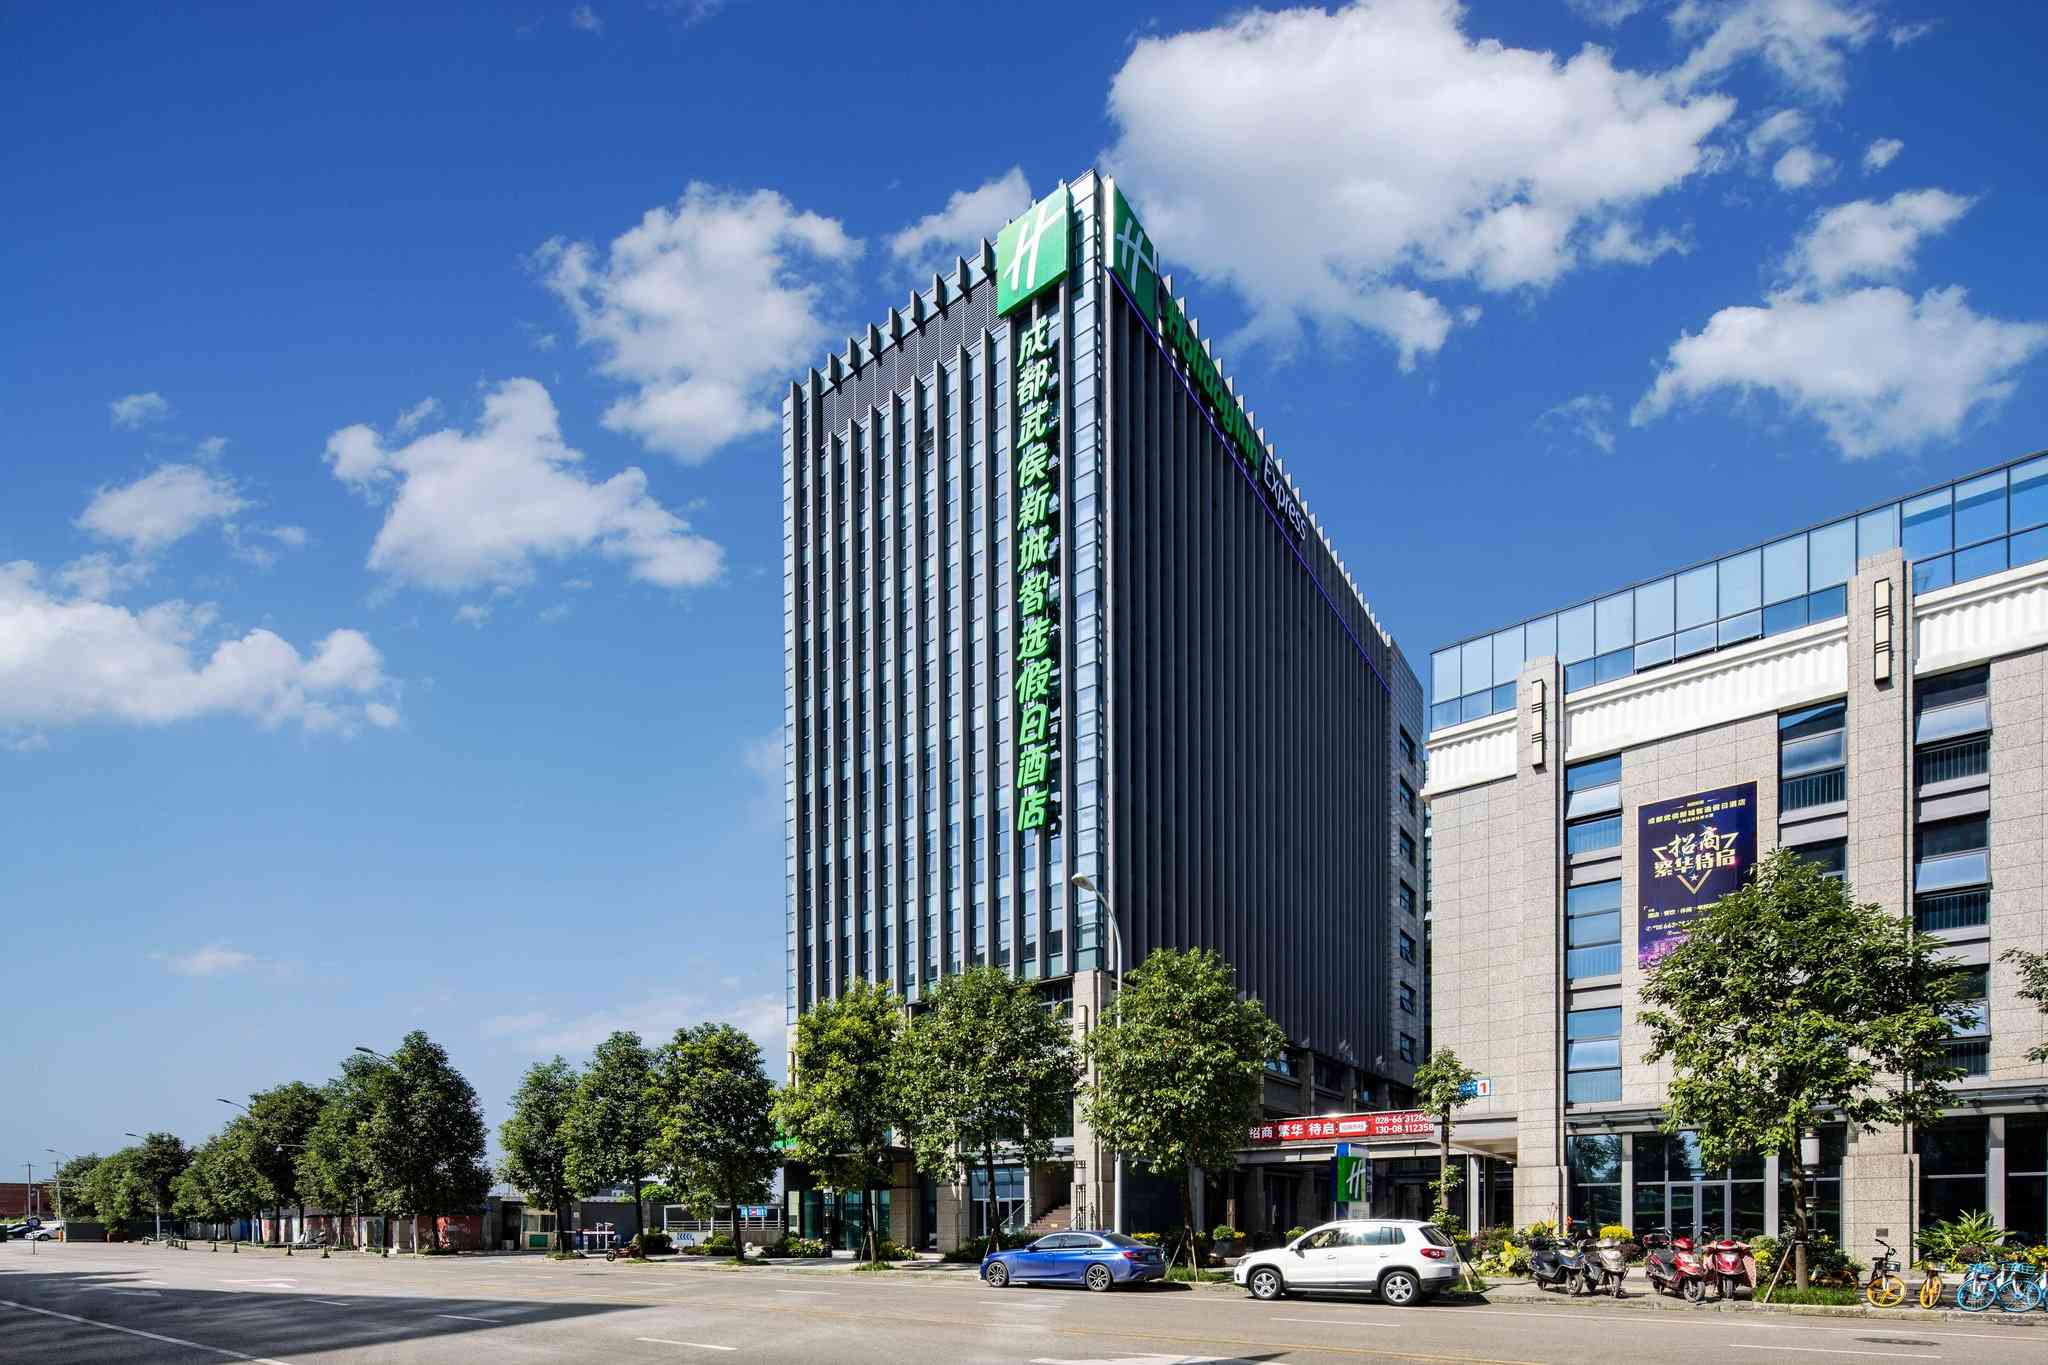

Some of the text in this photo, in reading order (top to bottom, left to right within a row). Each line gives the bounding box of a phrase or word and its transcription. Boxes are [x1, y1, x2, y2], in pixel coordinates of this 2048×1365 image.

[1263, 455, 1307, 542] Express
[1015, 315, 1050, 832] 成都武侯新城智选假日酒店
[1667, 826, 1720, 858] 招商
